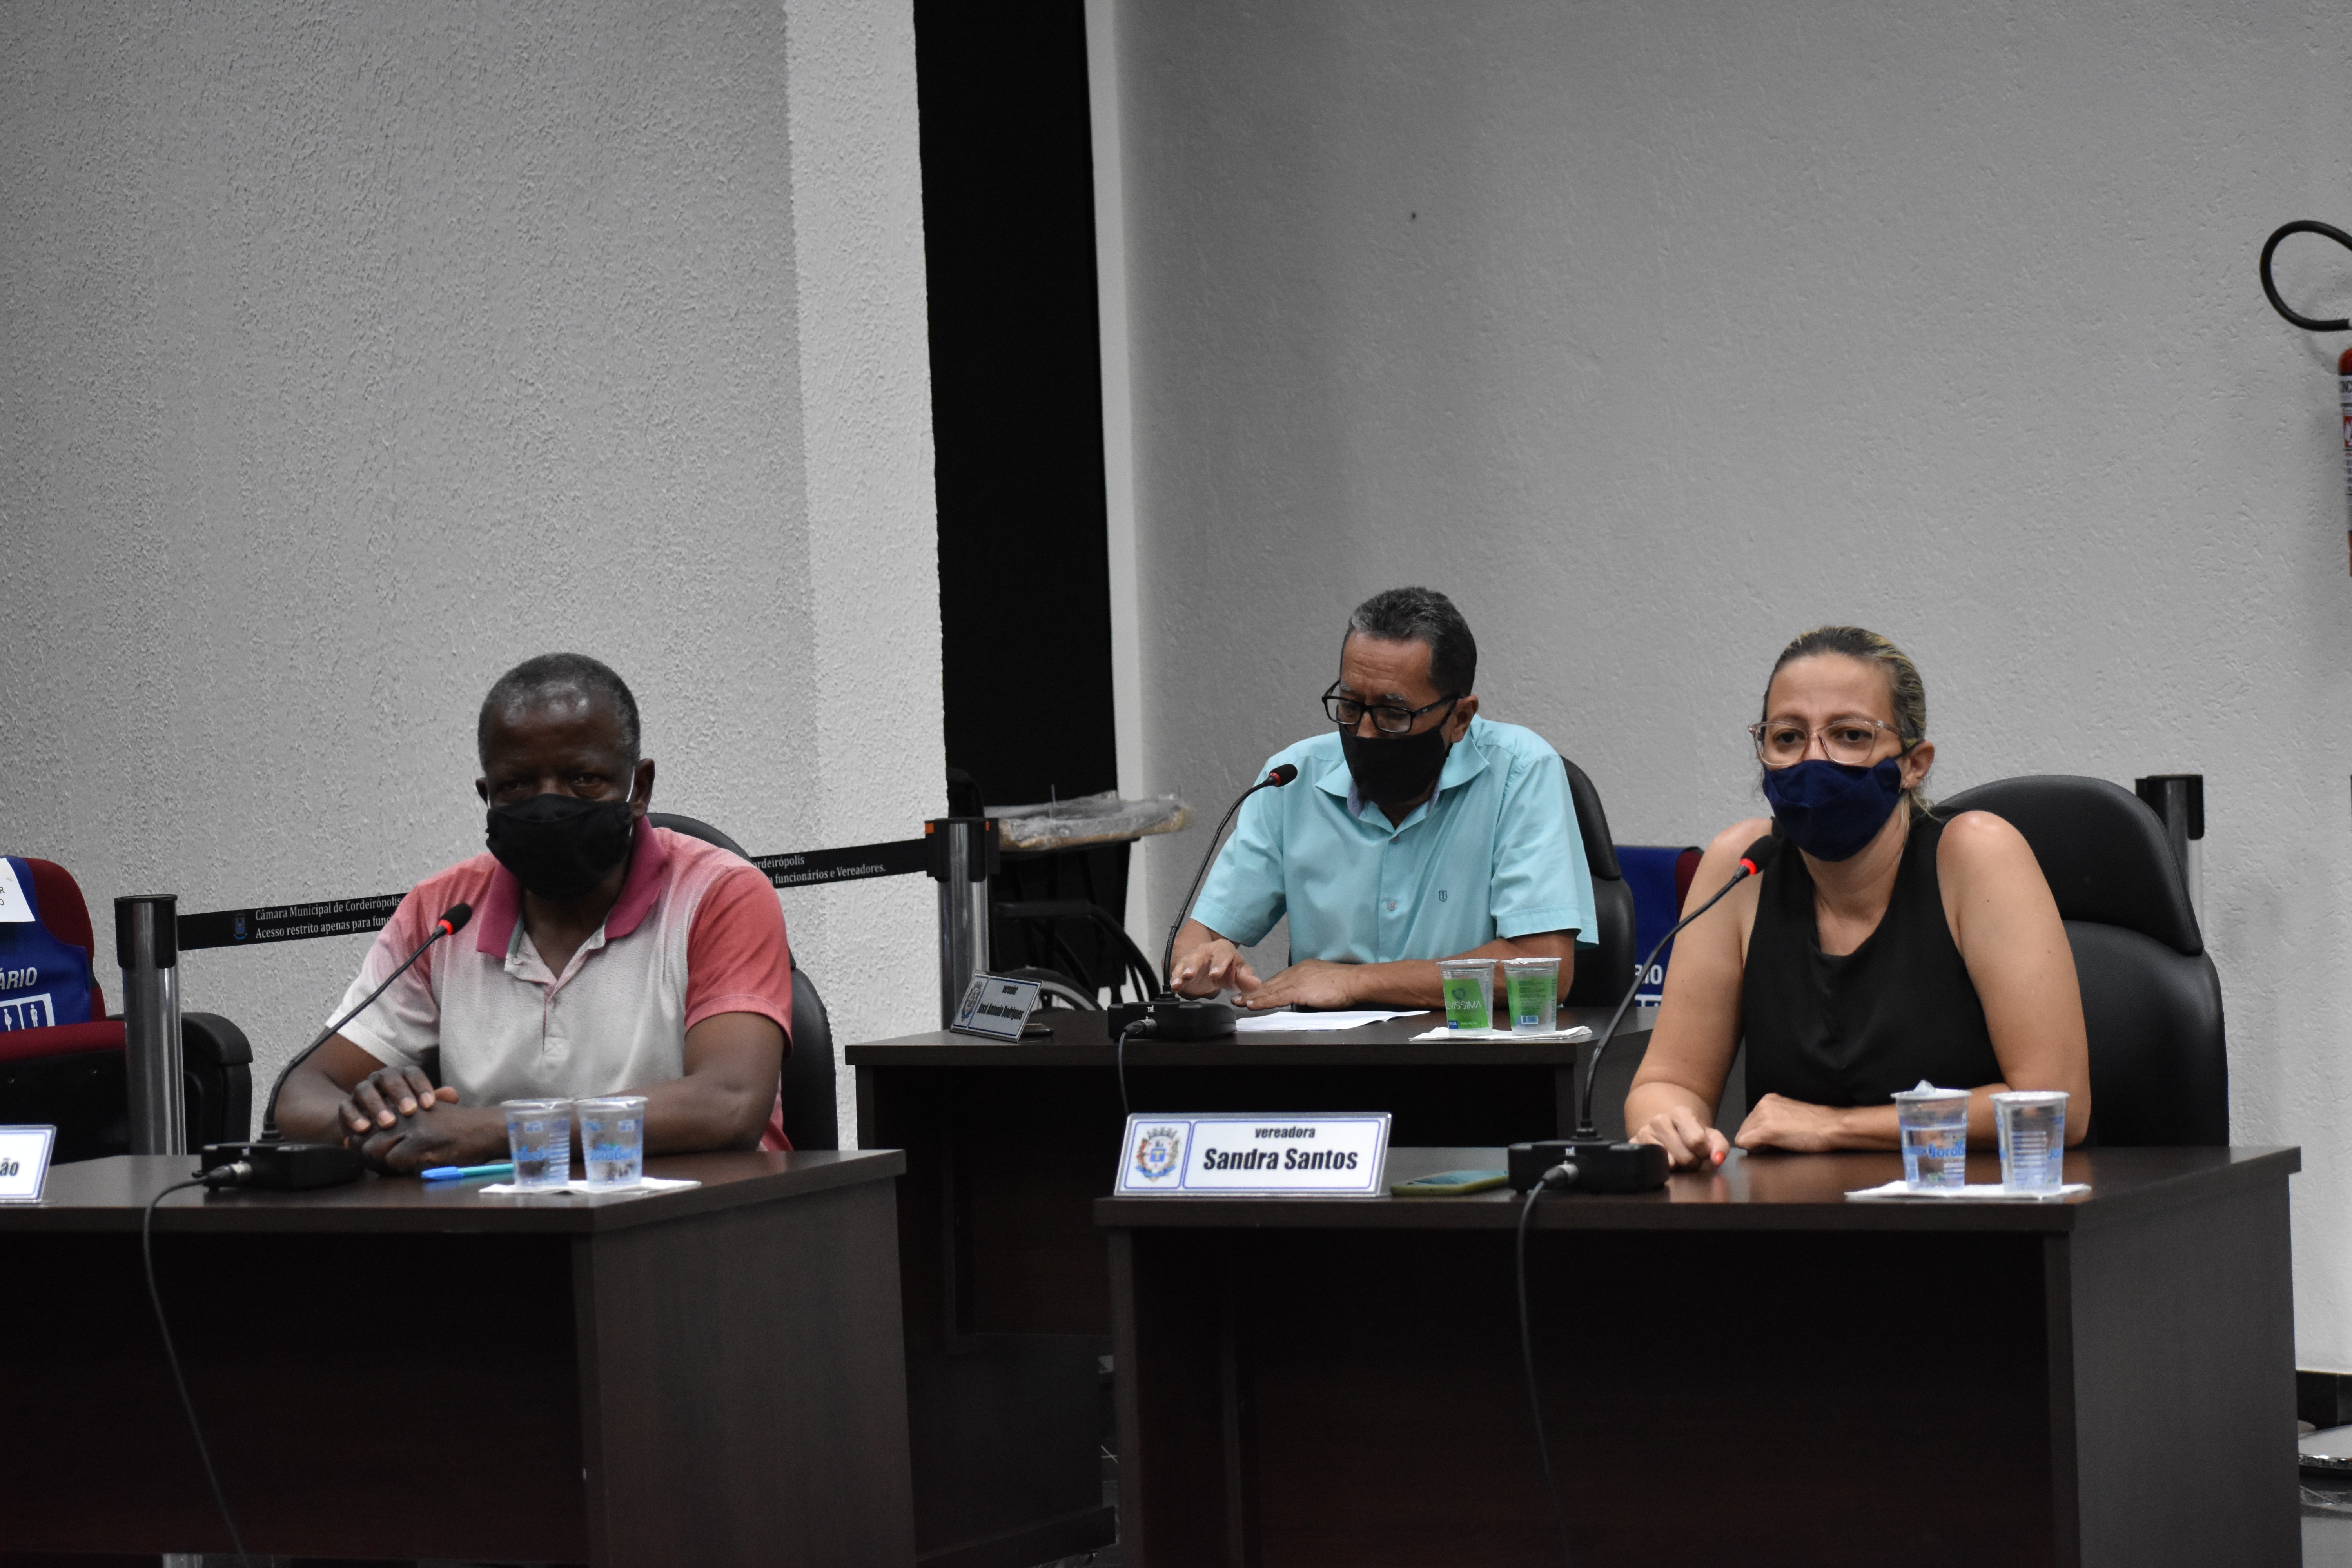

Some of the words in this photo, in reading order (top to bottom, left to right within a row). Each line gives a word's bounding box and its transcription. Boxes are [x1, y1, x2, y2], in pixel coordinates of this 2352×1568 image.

[752, 855, 805, 869] ordeirópolis
[775, 869, 828, 884] funcionários
[837, 864, 886, 877] Vereadores.
[256, 909, 288, 921] Câmara
[290, 903, 331, 918] Municipal
[333, 902, 343, 913] de
[345, 896, 401, 911] Cordeirópolis
[256, 927, 285, 939] Acesso
[287, 922, 319, 936] restrito
[321, 921, 350, 935] apenas
[352, 918, 371, 931] para
[373, 915, 392, 927] func
[0, 967, 37, 990] ÁRIO
[1255, 1126, 1316, 1138] vereadora
[0, 1157, 19, 1176] ão
[1203, 1147, 1279, 1170] Sandra
[1284, 1147, 1358, 1170] Santos
